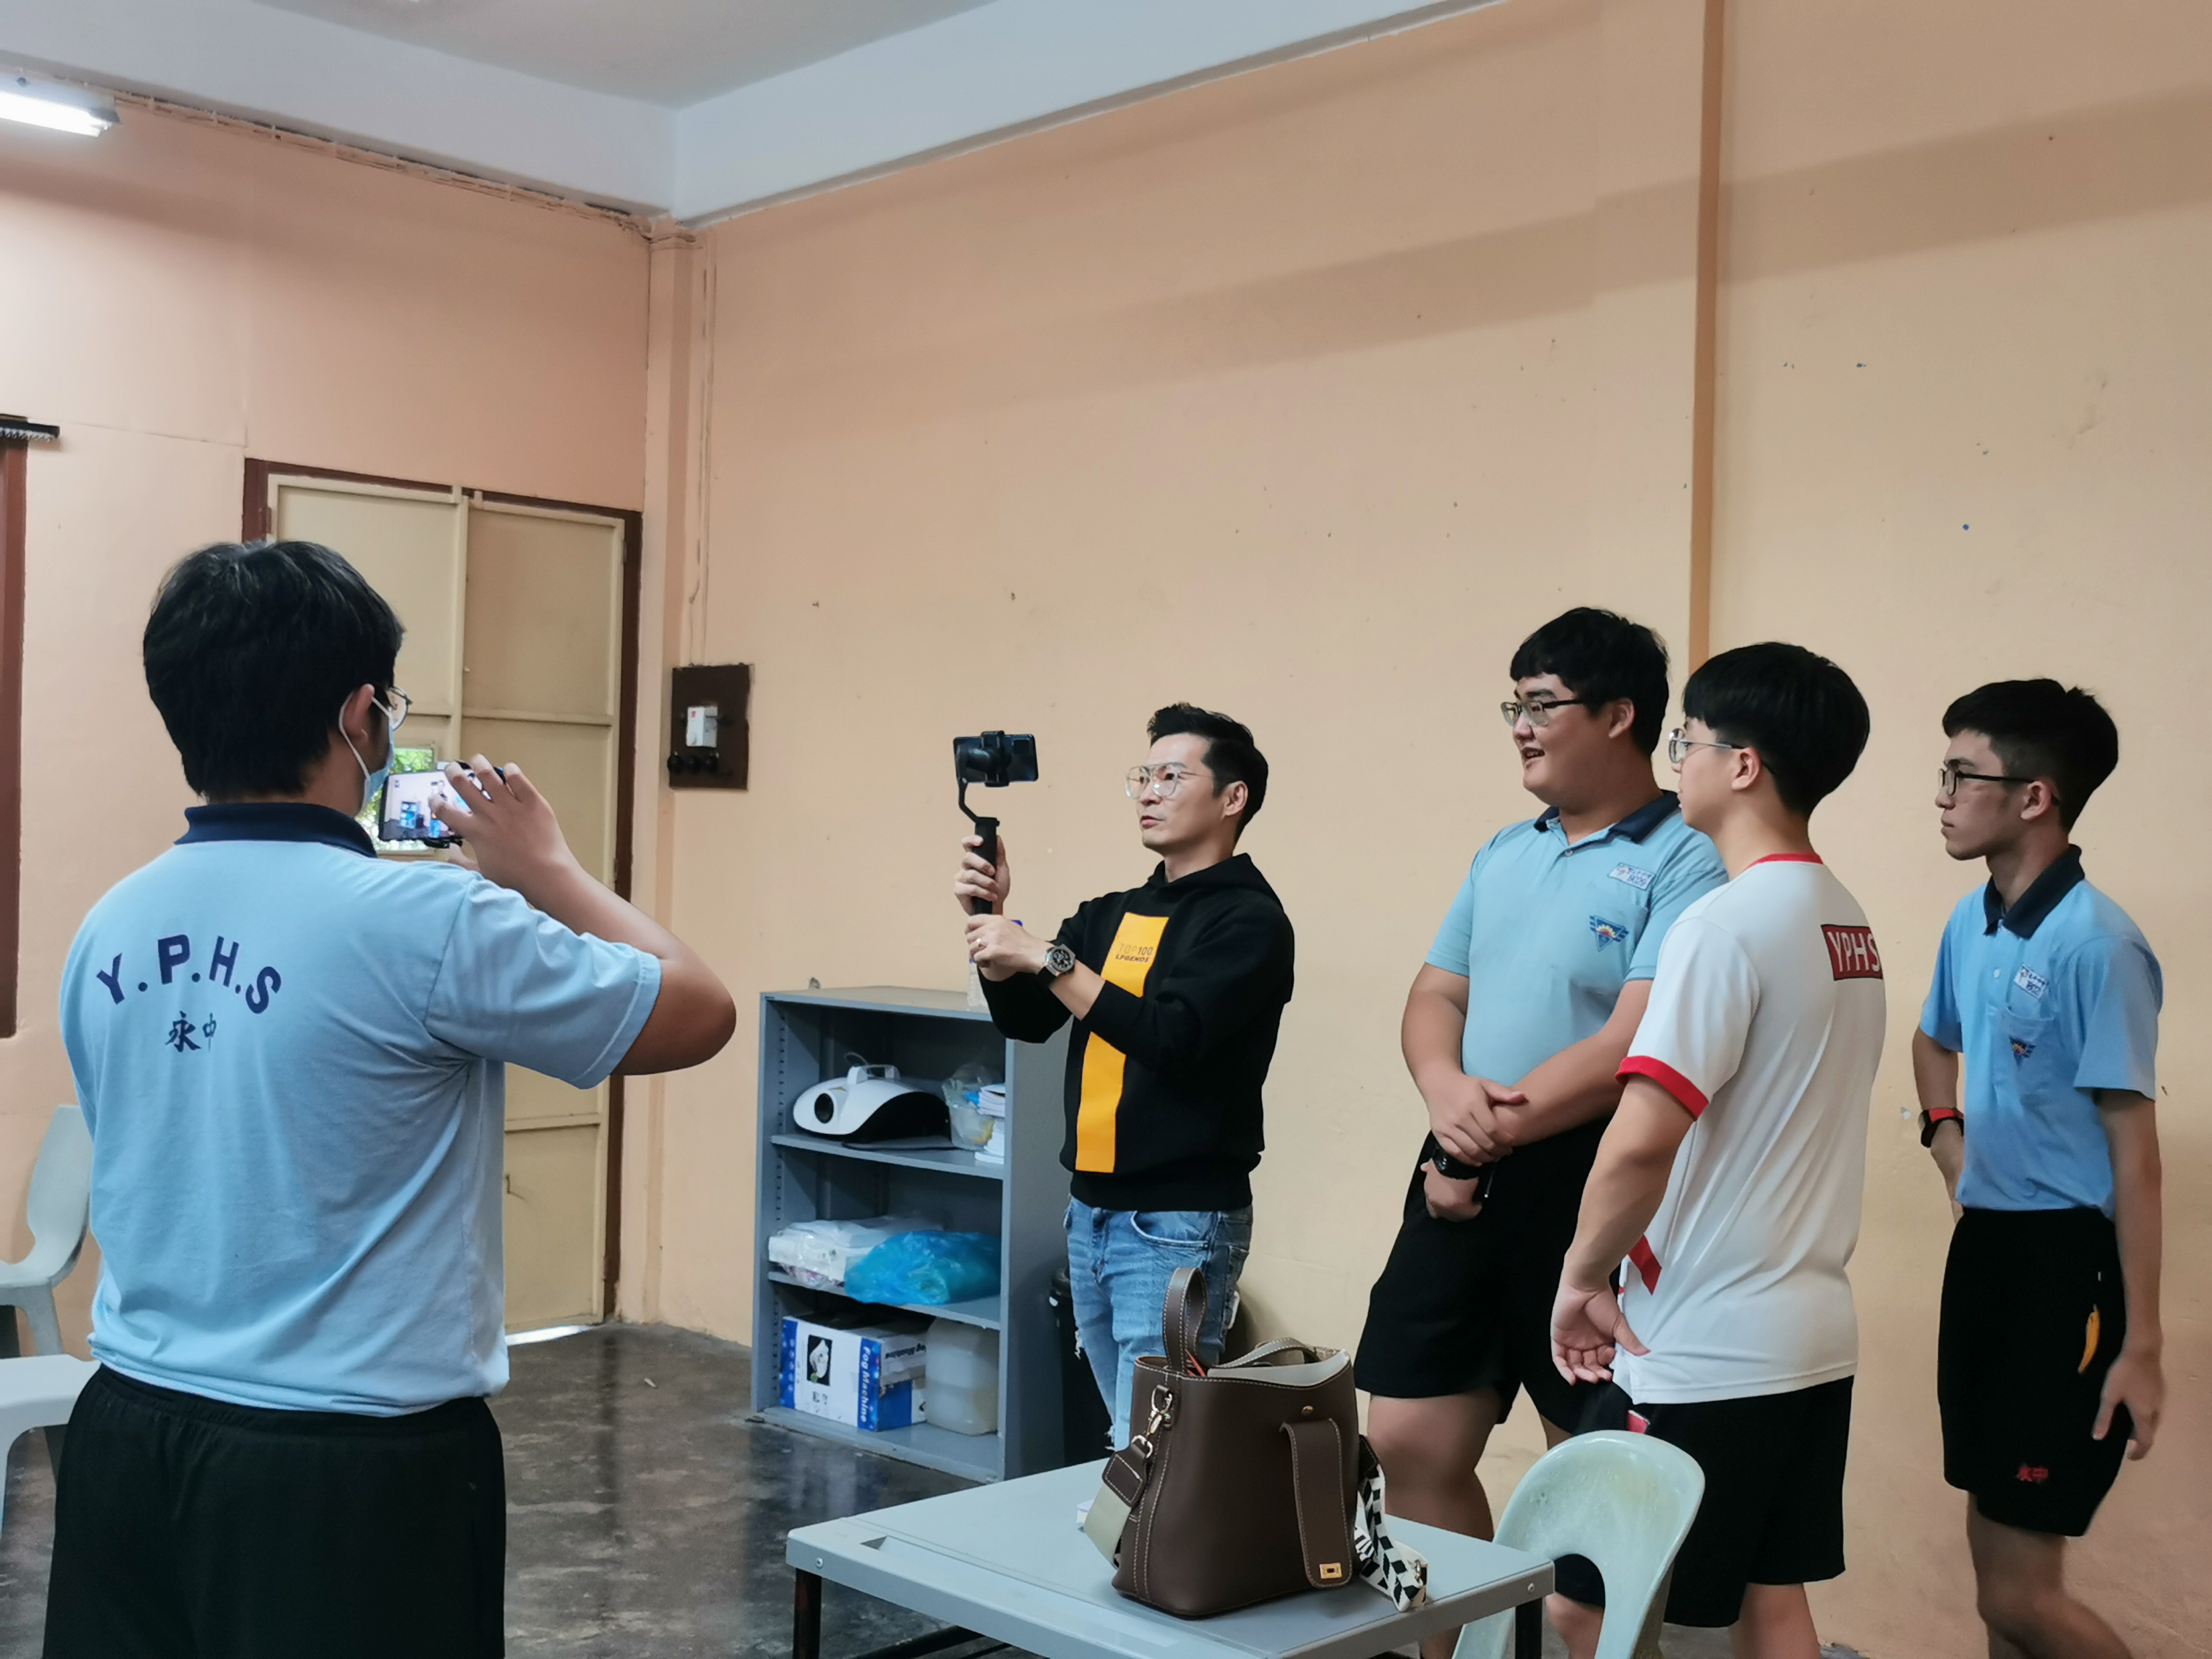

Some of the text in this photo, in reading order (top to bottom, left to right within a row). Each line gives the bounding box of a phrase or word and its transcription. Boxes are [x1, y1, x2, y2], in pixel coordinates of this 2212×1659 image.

[96, 934, 281, 1014] Y.P.H.S
[1826, 931, 1880, 972] YPHS
[165, 1010, 216, 1053] 永中
[860, 1346, 871, 1423] Fog Machine
